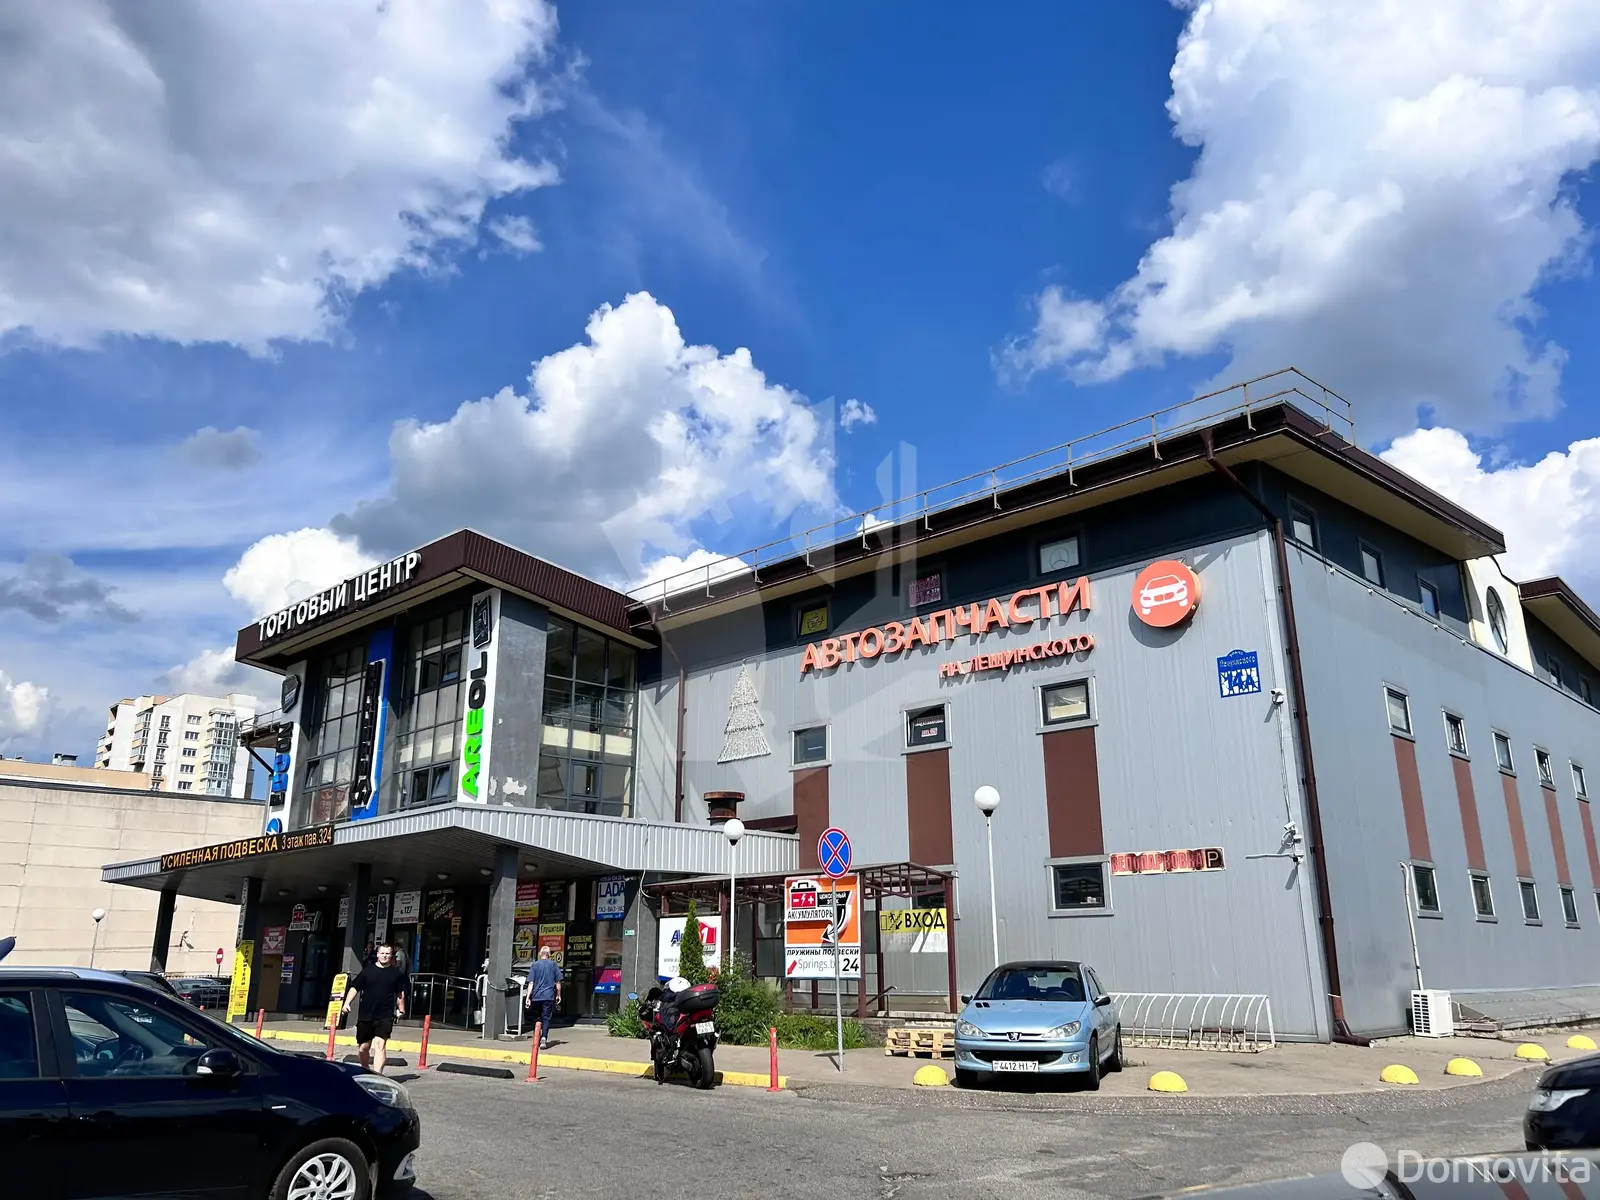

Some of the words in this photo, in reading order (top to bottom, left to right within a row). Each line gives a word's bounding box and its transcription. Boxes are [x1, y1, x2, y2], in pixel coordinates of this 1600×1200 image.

[258, 580, 348, 642] ТОРГОВЫЙ
[354, 552, 421, 602] ЦЕНТР
[800, 576, 1091, 674] АВТОЗАПЧАСТИ
[939, 661, 964, 678] НА
[966, 634, 1095, 671] ЛЕЩИНСКОГО
[461, 651, 488, 799] AREOL
[161, 846, 218, 870] УСИЛЕННАЯ
[219, 836, 278, 859] ПОДВЕСКА
[281, 834, 286, 850] 3
[286, 835, 303, 849] этаж
[304, 827, 332, 846] пав.324
[1111, 850, 1205, 873] ВЕЛОПАРКОВКА
[599, 882, 625, 898] LADA
[905, 912, 945, 929] ВХОД
[798, 959, 839, 971] Springs.b
[842, 958, 860, 972] 24
[1000, 1062, 1017, 1071] 4412
